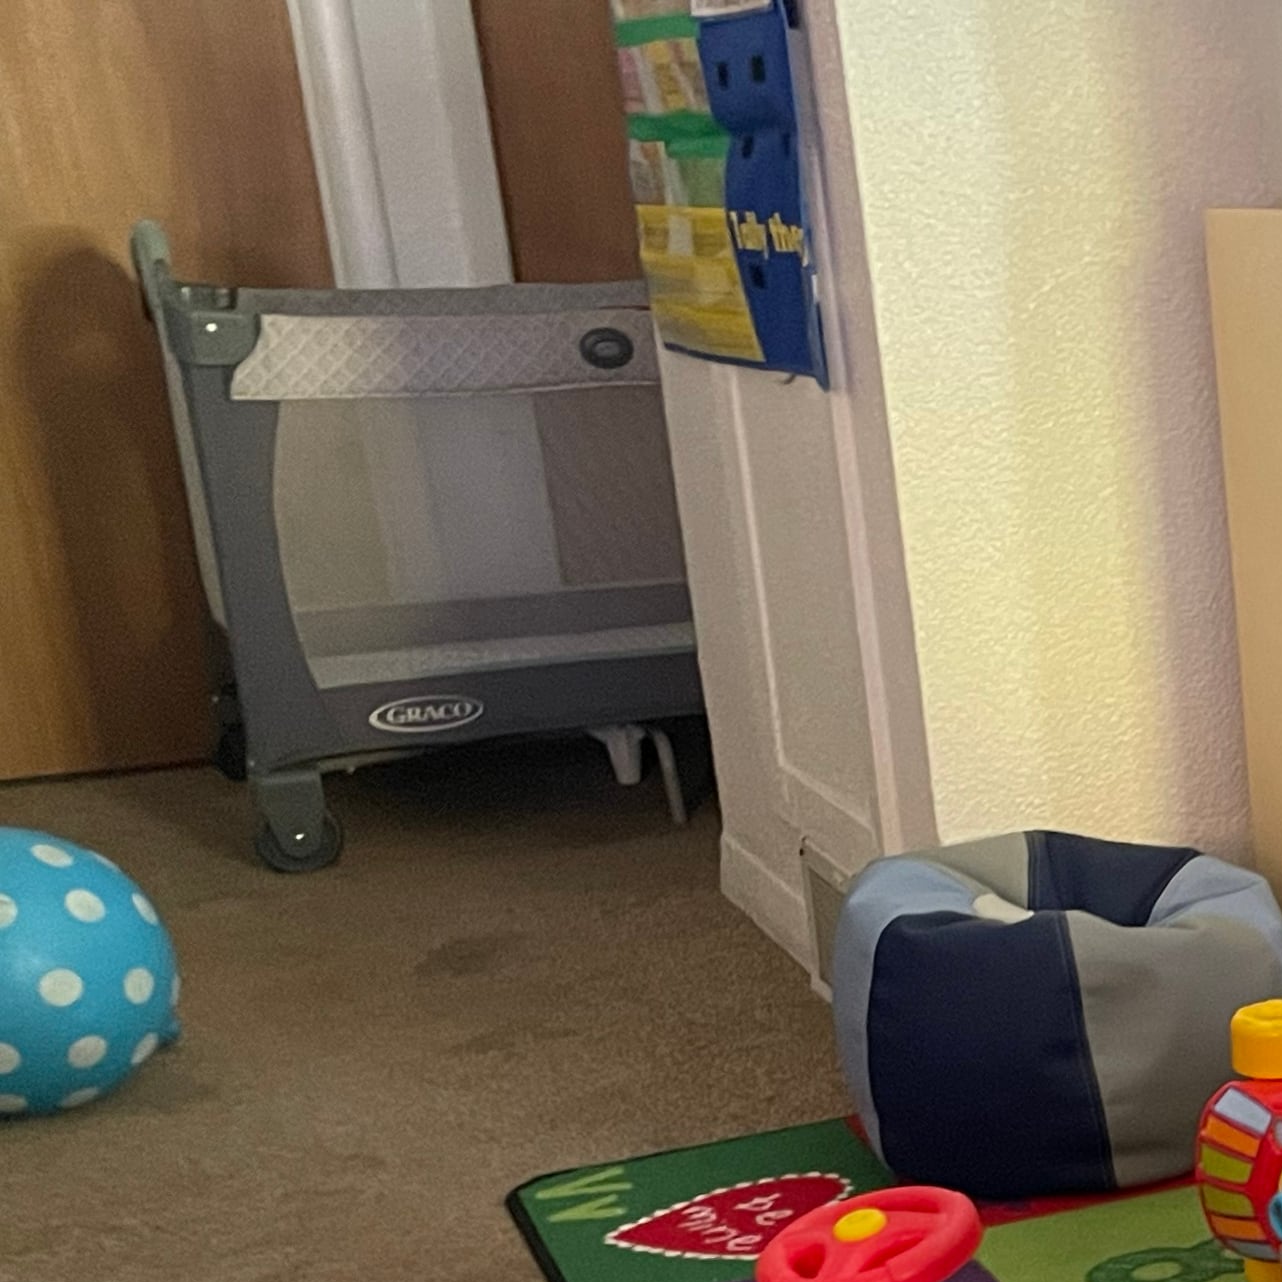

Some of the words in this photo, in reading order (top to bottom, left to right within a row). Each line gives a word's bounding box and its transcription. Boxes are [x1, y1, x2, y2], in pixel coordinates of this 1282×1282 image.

[386, 701, 474, 724] GRACO
[733, 1193, 795, 1226] be
[677, 1205, 763, 1252] mine
